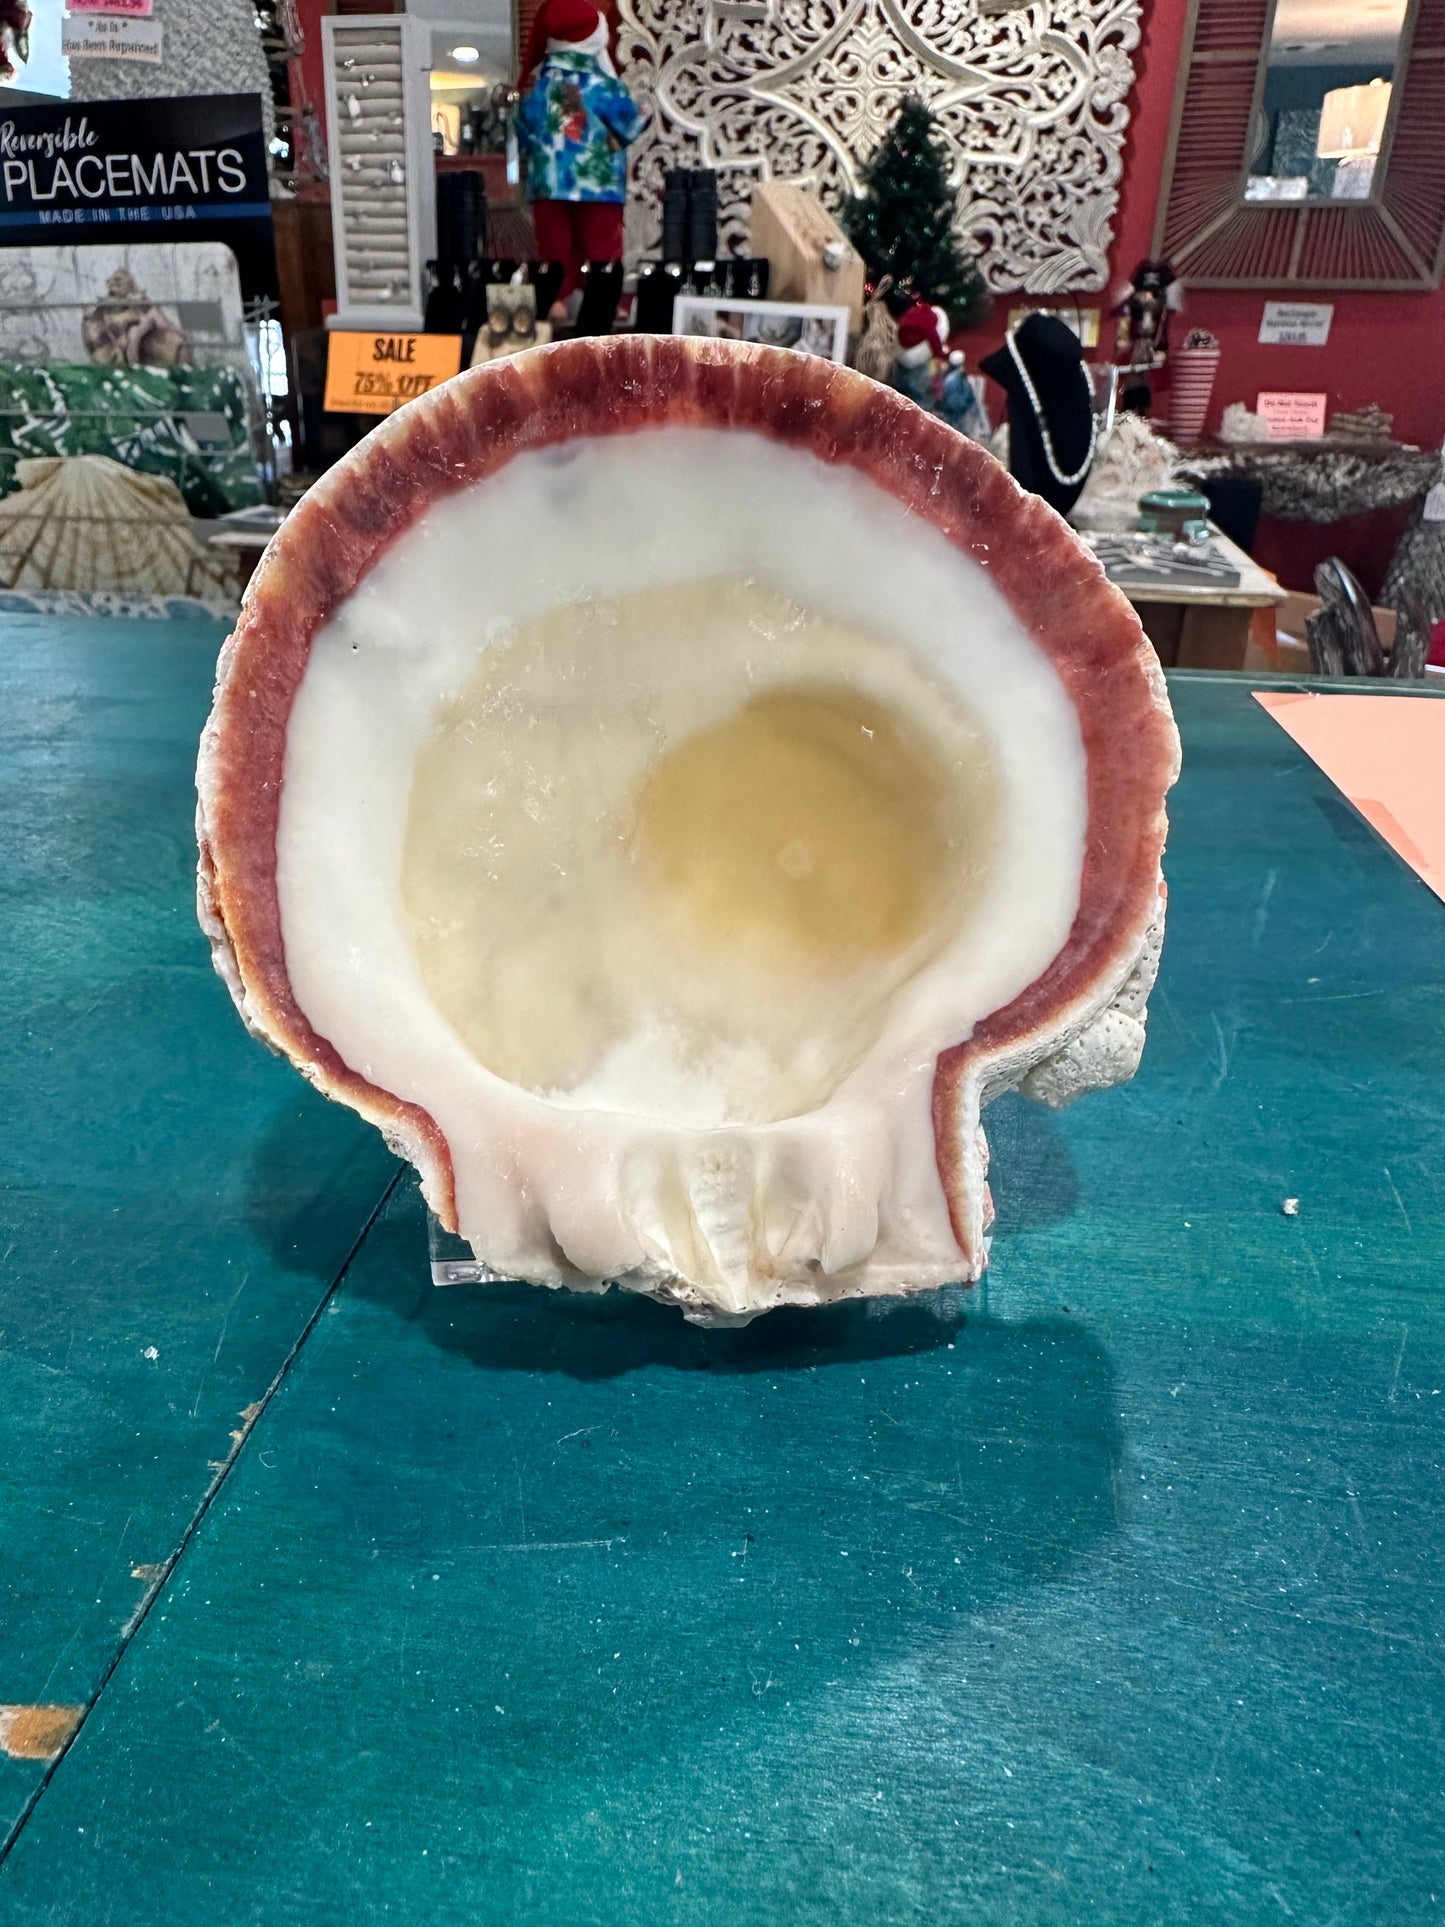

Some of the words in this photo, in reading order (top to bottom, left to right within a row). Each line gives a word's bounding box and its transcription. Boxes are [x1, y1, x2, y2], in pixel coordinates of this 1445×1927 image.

[0, 117, 99, 158] Reversible
[3, 149, 247, 201] PLACEMATS
[39, 208, 85, 224] MADE
[92, 208, 110, 222] IN
[119, 206, 151, 221] THE
[161, 205, 197, 220] USA
[372, 338, 417, 362] SALE
[354, 371, 393, 395] 75%
